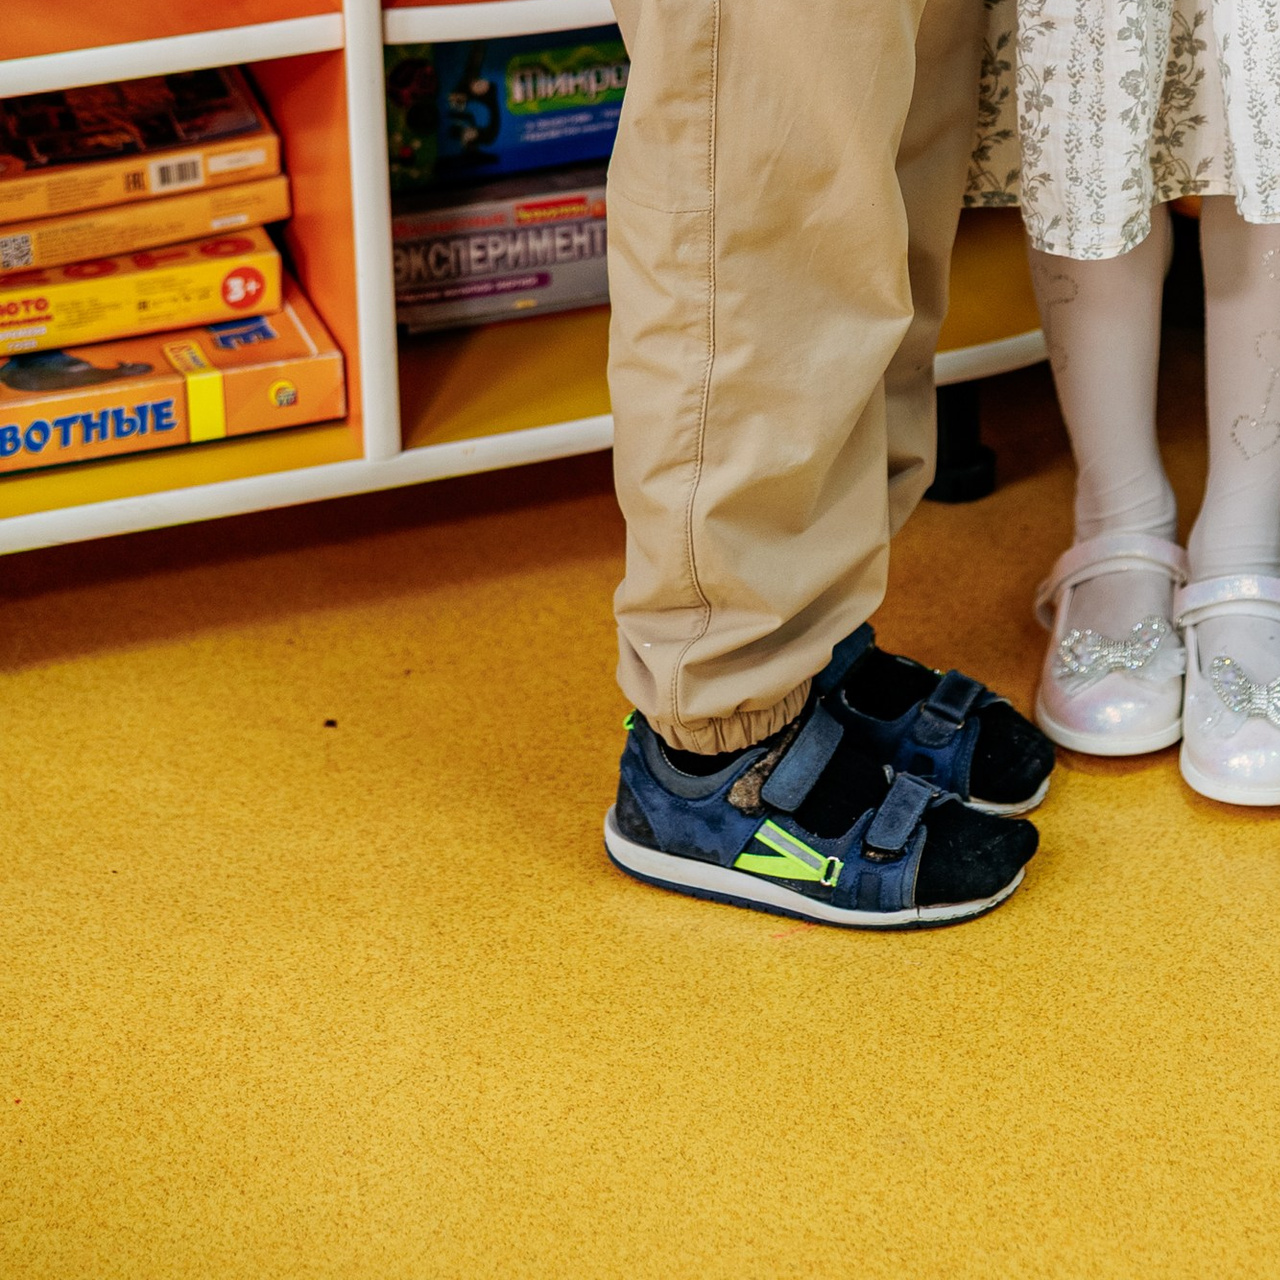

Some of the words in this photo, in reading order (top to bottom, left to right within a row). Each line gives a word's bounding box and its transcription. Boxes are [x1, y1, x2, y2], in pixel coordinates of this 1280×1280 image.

[394, 219, 608, 281] ЭКСПЕРИМЕНТ
[226, 276, 261, 304] 3+
[0, 399, 177, 457] ВОТНЫЕ
